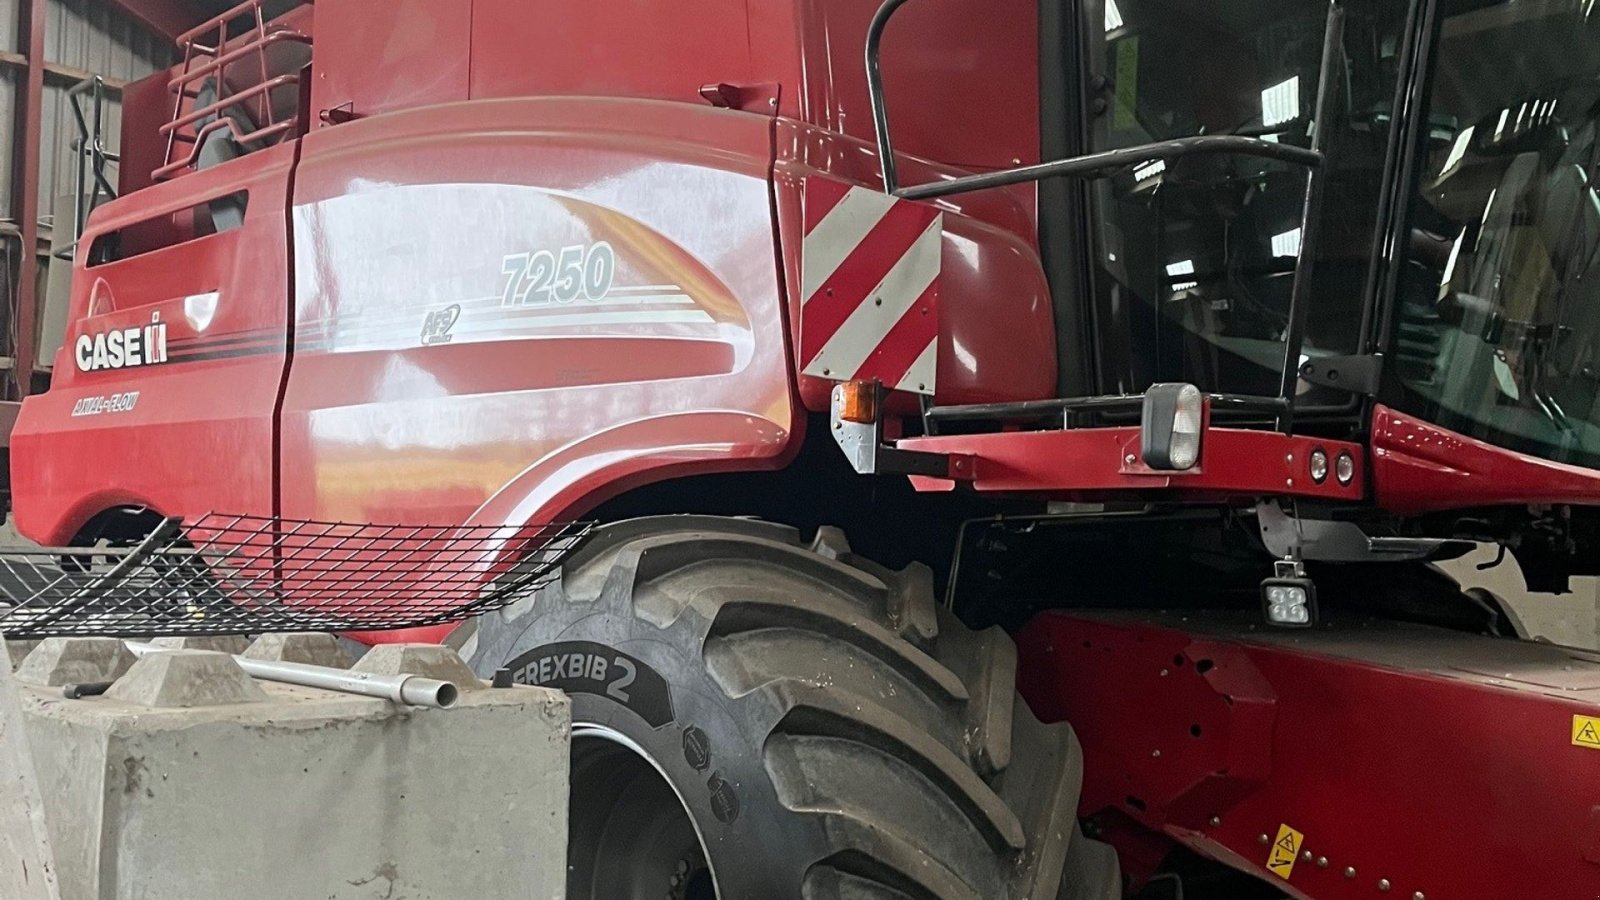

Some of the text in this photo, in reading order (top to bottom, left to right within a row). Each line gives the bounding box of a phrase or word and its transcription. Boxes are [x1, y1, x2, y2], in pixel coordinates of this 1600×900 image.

[502, 241, 614, 308] 7250
[76, 328, 141, 371] CASE
[71, 391, 140, 416] AXIAL-FLOW
[606, 656, 637, 703] 2
